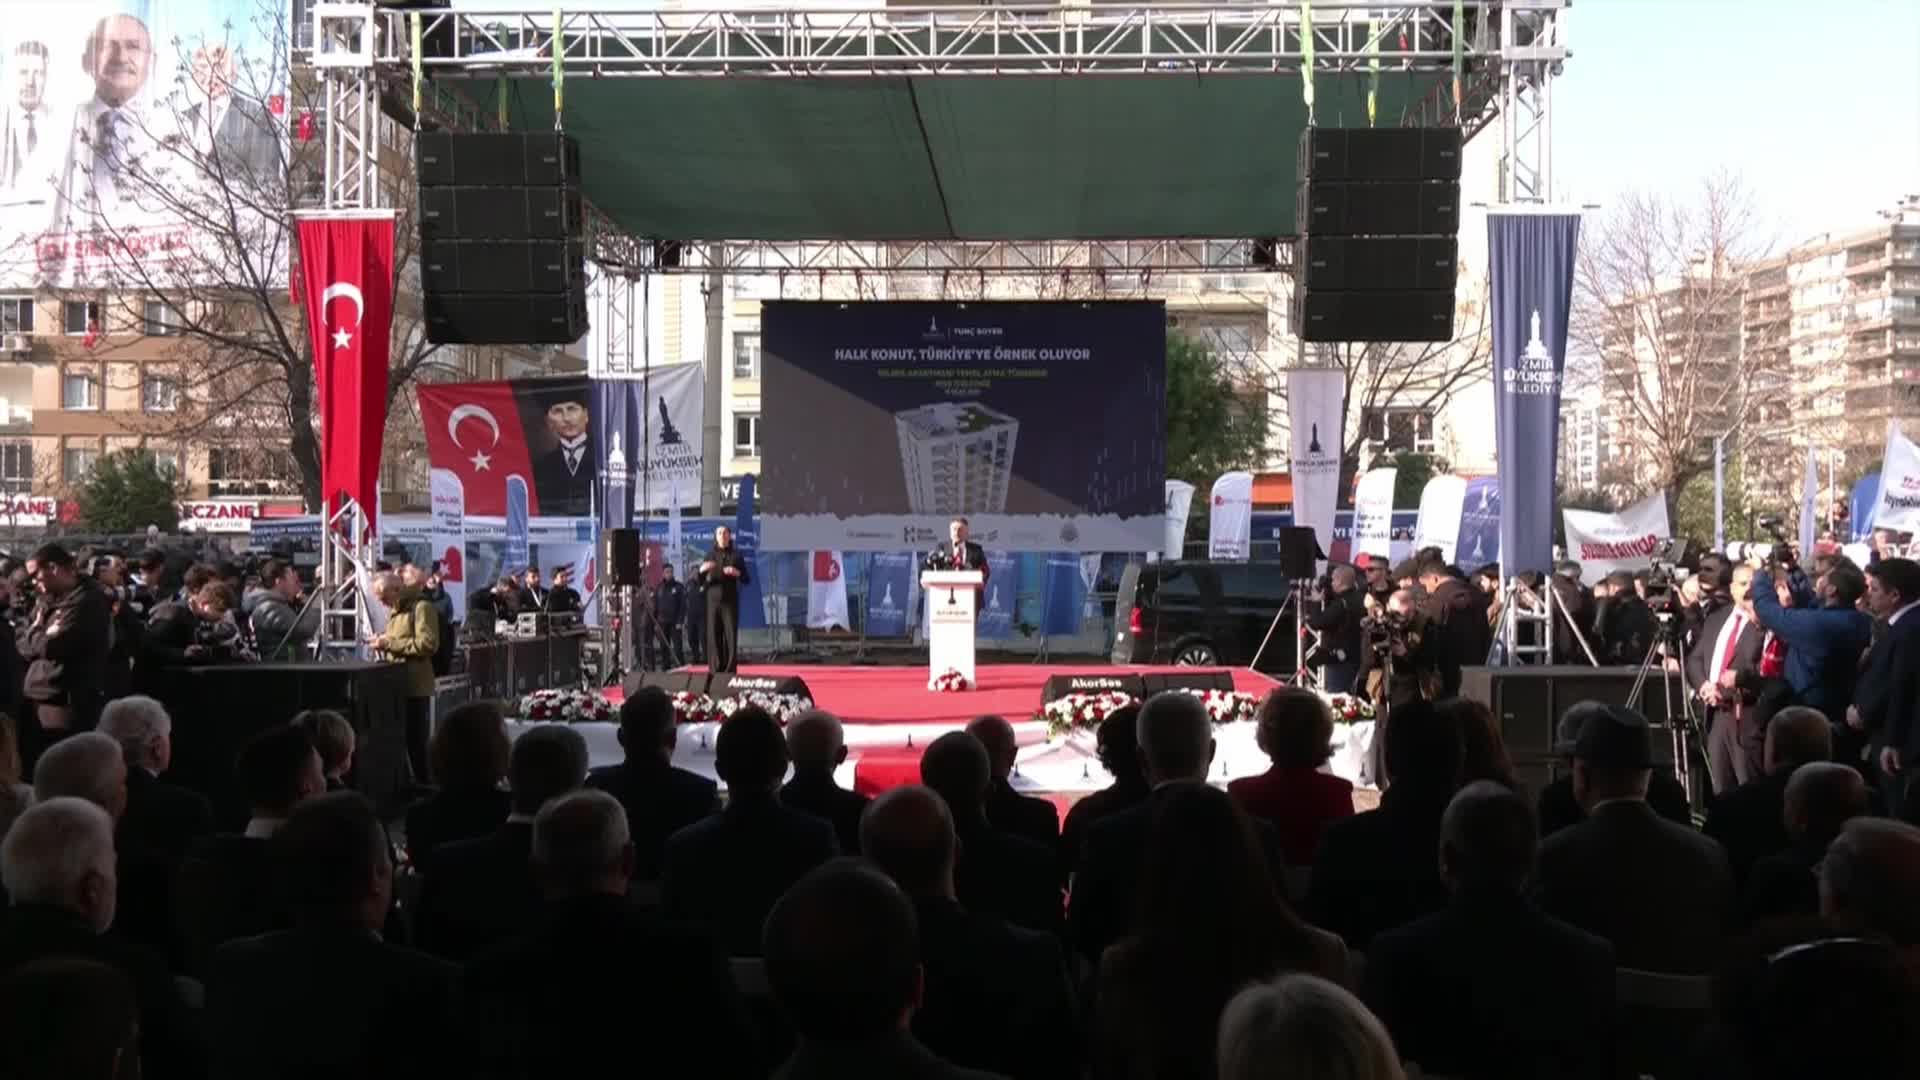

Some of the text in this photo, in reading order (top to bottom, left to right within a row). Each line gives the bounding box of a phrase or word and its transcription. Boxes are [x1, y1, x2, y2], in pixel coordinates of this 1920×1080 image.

[835, 345, 1090, 363] HALK KONUT, TÜRKİYE'YE ÖRNEK OLUYOR
[182, 504, 256, 519] ECZANE
[1071, 678, 1122, 688] AkorSes
